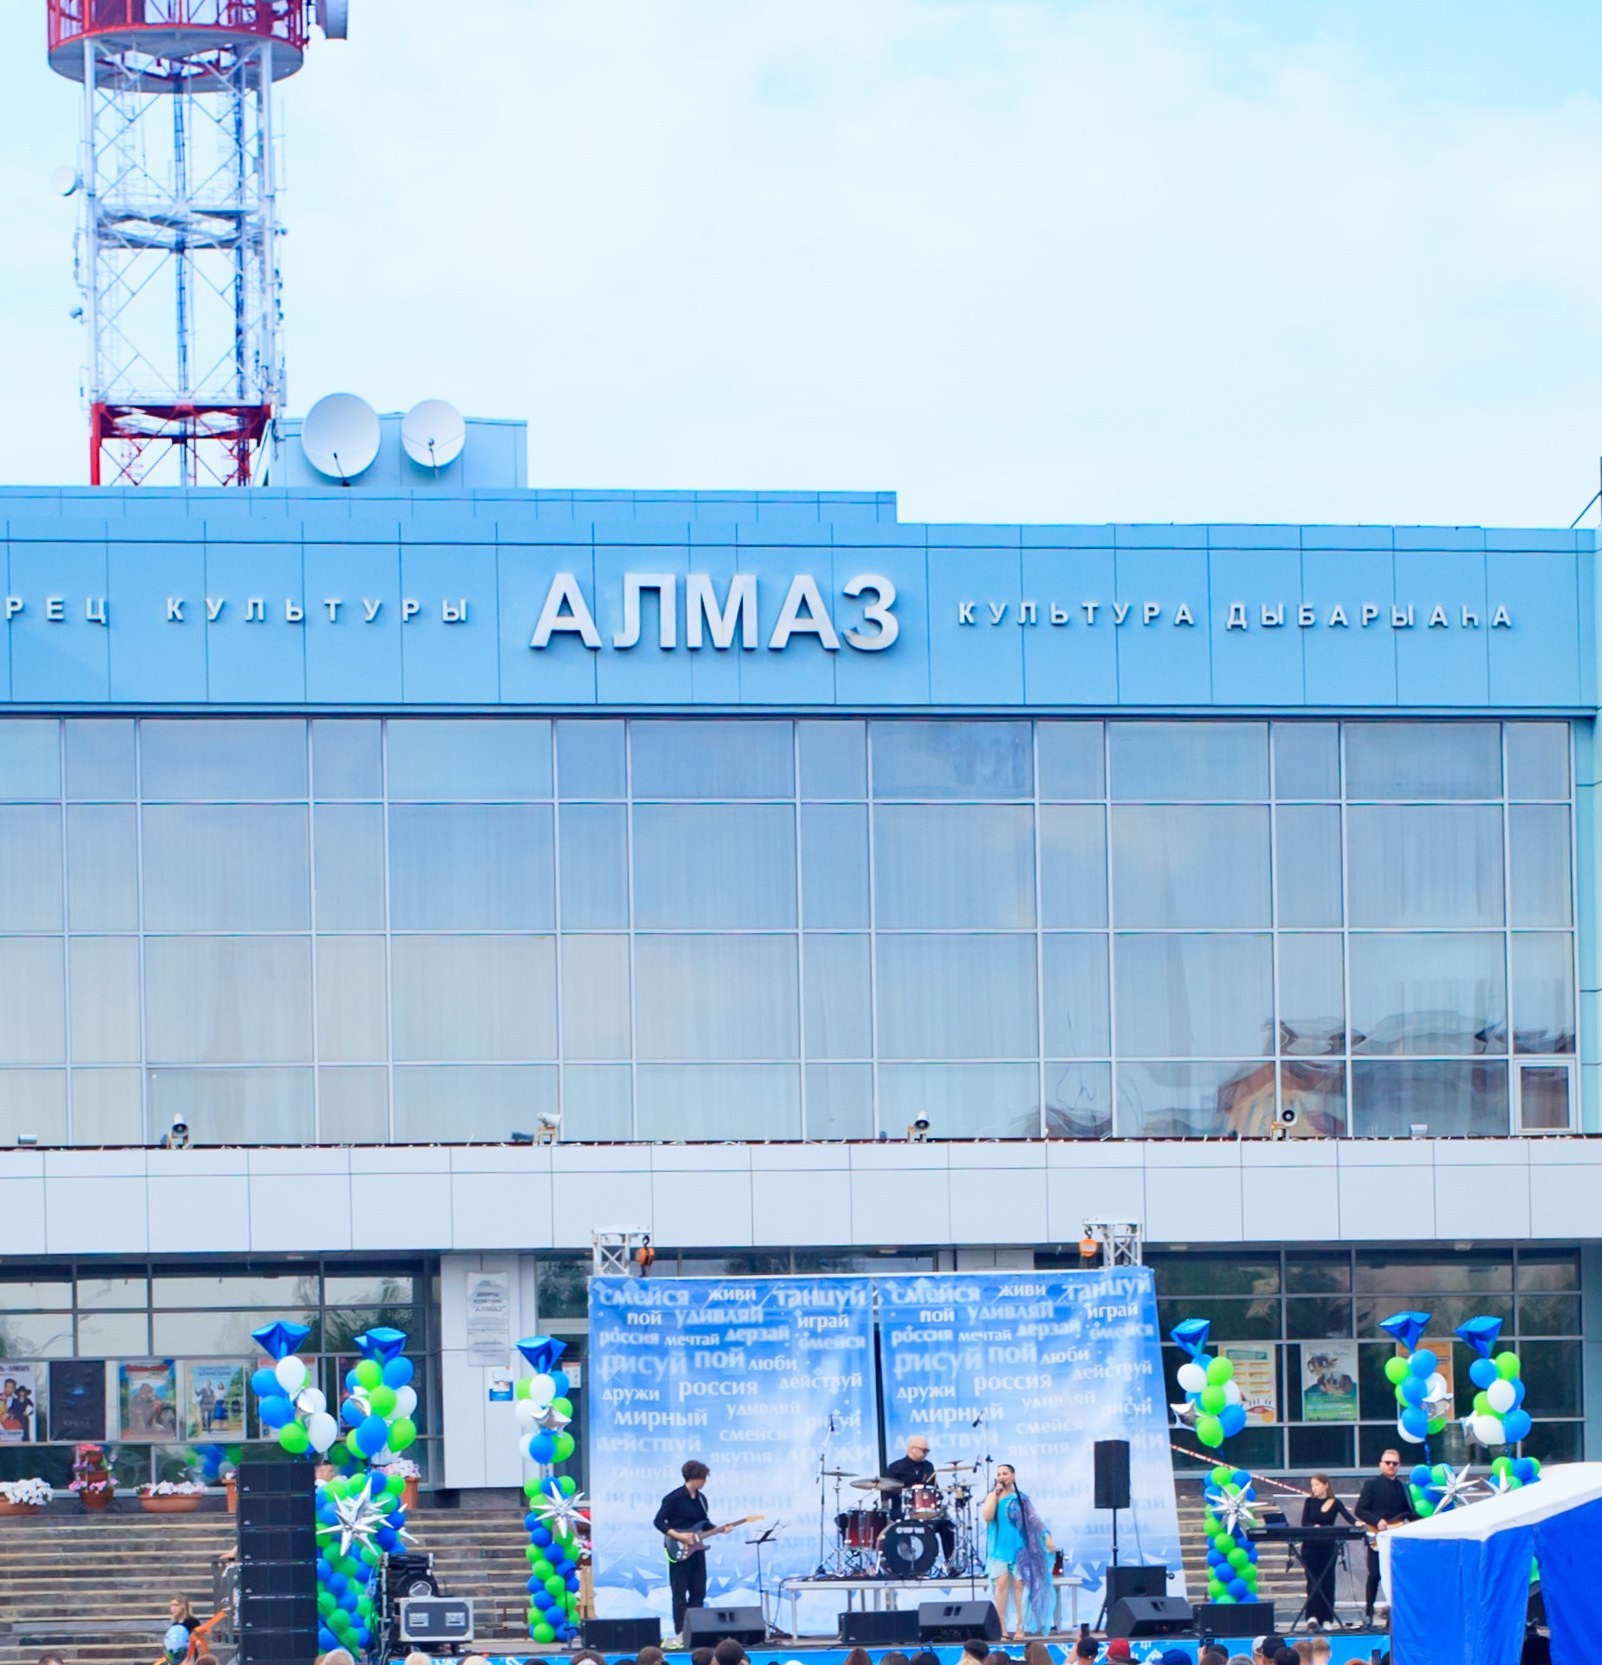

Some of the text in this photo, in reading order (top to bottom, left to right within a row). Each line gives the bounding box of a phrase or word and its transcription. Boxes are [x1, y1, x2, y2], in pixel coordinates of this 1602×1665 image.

[166, 597, 471, 625] КУЛЬТУРЫ
[529, 570, 900, 654] АЛМАЗ
[956, 600, 1196, 628] КУЛЬТУРА
[599, 1286, 689, 1306] смейся
[709, 1288, 757, 1301] живи
[892, 1285, 981, 1305] смейся
[999, 1283, 1046, 1297] живи
[1063, 1274, 1151, 1300] танцуй
[775, 1285, 866, 1310] танцуй
[627, 1310, 661, 1325] пой
[675, 1307, 763, 1328] удивляй
[920, 1308, 955, 1322] пой
[968, 1303, 1054, 1325] удивляй
[1087, 1303, 1139, 1322] играй
[799, 1314, 849, 1332] играй
[1017, 1320, 1080, 1340] дерзай
[600, 1331, 659, 1347] россия
[665, 1333, 720, 1346] мечтай
[725, 1325, 789, 1345] дерзай
[891, 1328, 953, 1346] россия
[958, 1330, 1012, 1342] мечтай
[694, 1347, 745, 1368] пой
[749, 1355, 797, 1371] люби
[893, 1346, 982, 1380] рисуй
[988, 1342, 1037, 1364] пой
[1040, 1348, 1090, 1365] люби
[600, 1350, 687, 1382] рисуй
[1073, 1361, 1152, 1381] действуй
[679, 1381, 758, 1402] россия
[780, 1373, 862, 1390] действуй
[974, 1374, 1052, 1396] россия
[602, 1388, 660, 1405] дружи
[897, 1385, 955, 1403] дружи
[614, 1408, 708, 1431] мирный
[910, 1403, 1004, 1428] мирный
[720, 1428, 787, 1441] смейся
[1016, 1420, 1083, 1434] смейся
[597, 1435, 701, 1459] действуй
[709, 1450, 773, 1464] якутия
[1008, 1442, 1069, 1457] якутия
